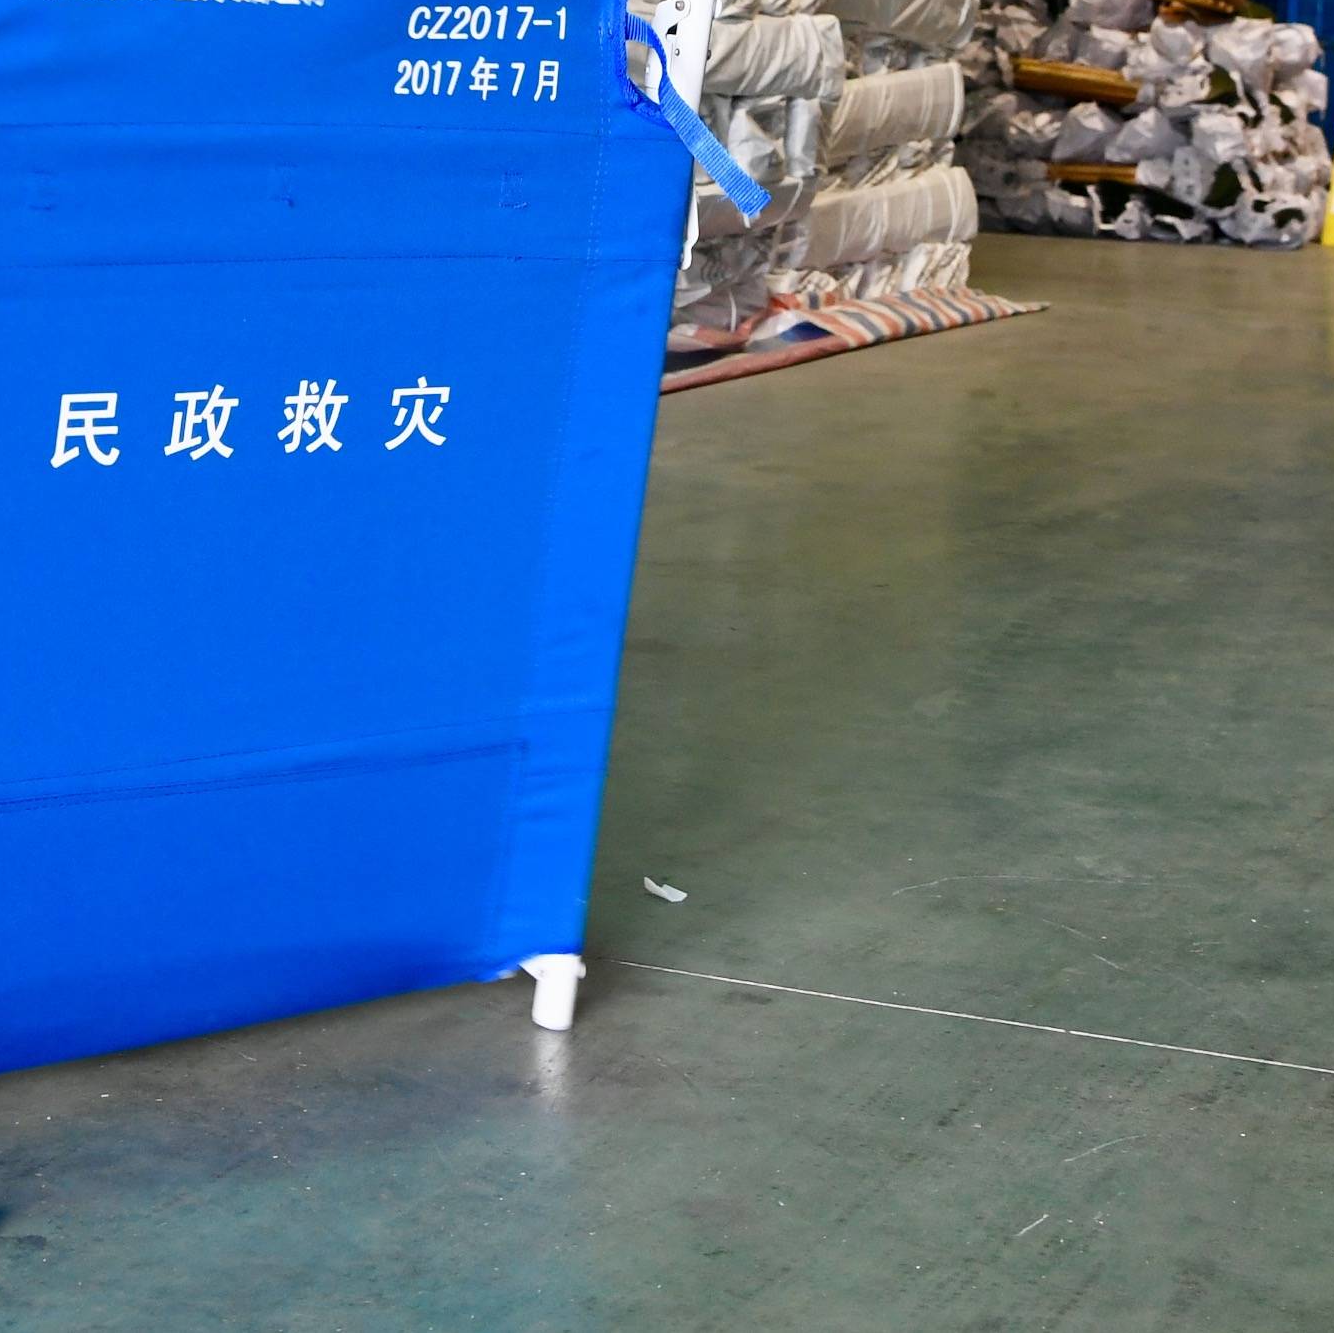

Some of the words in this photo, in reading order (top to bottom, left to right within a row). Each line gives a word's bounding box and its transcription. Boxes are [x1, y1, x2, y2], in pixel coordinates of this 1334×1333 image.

[407, 6, 568, 41] CZ2017-1
[51, 377, 451, 469] 民政救灾
